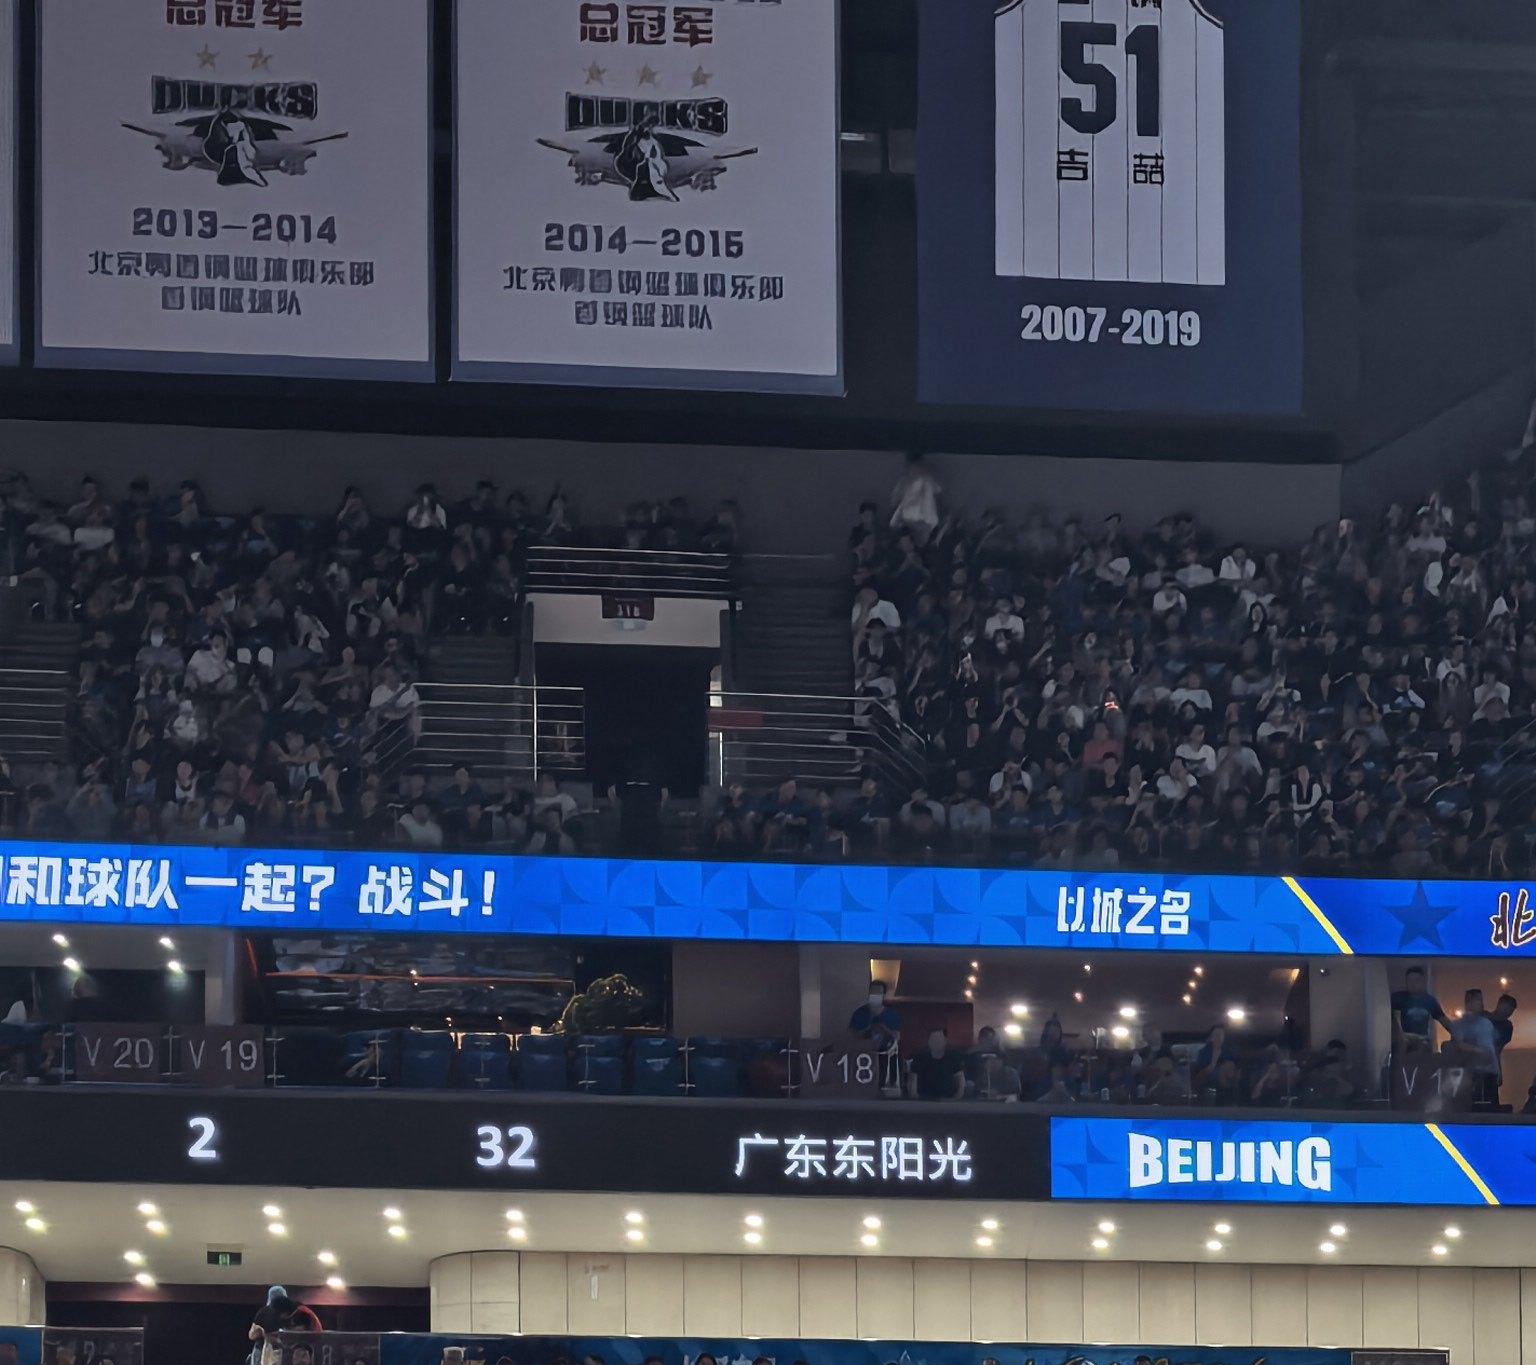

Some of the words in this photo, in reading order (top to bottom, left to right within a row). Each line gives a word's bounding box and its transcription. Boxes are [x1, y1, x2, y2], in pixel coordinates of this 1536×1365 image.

[579, 2, 713, 47] 总冠军
[1060, 21, 1160, 137] 51
[1021, 305, 1201, 346] 2007-2019
[1057, 886, 1191, 936] 以城之名
[81, 1036, 101, 1067] V
[113, 1037, 153, 1070] 20
[189, 1037, 206, 1069] V
[221, 1038, 258, 1071] 19
[807, 1053, 824, 1083] V
[837, 1053, 873, 1084] 18
[188, 1117, 218, 1159] 2
[476, 1125, 537, 1168] 32
[735, 1132, 972, 1181] 广东东阳光
[1128, 1132, 1331, 1192] BEIJING
